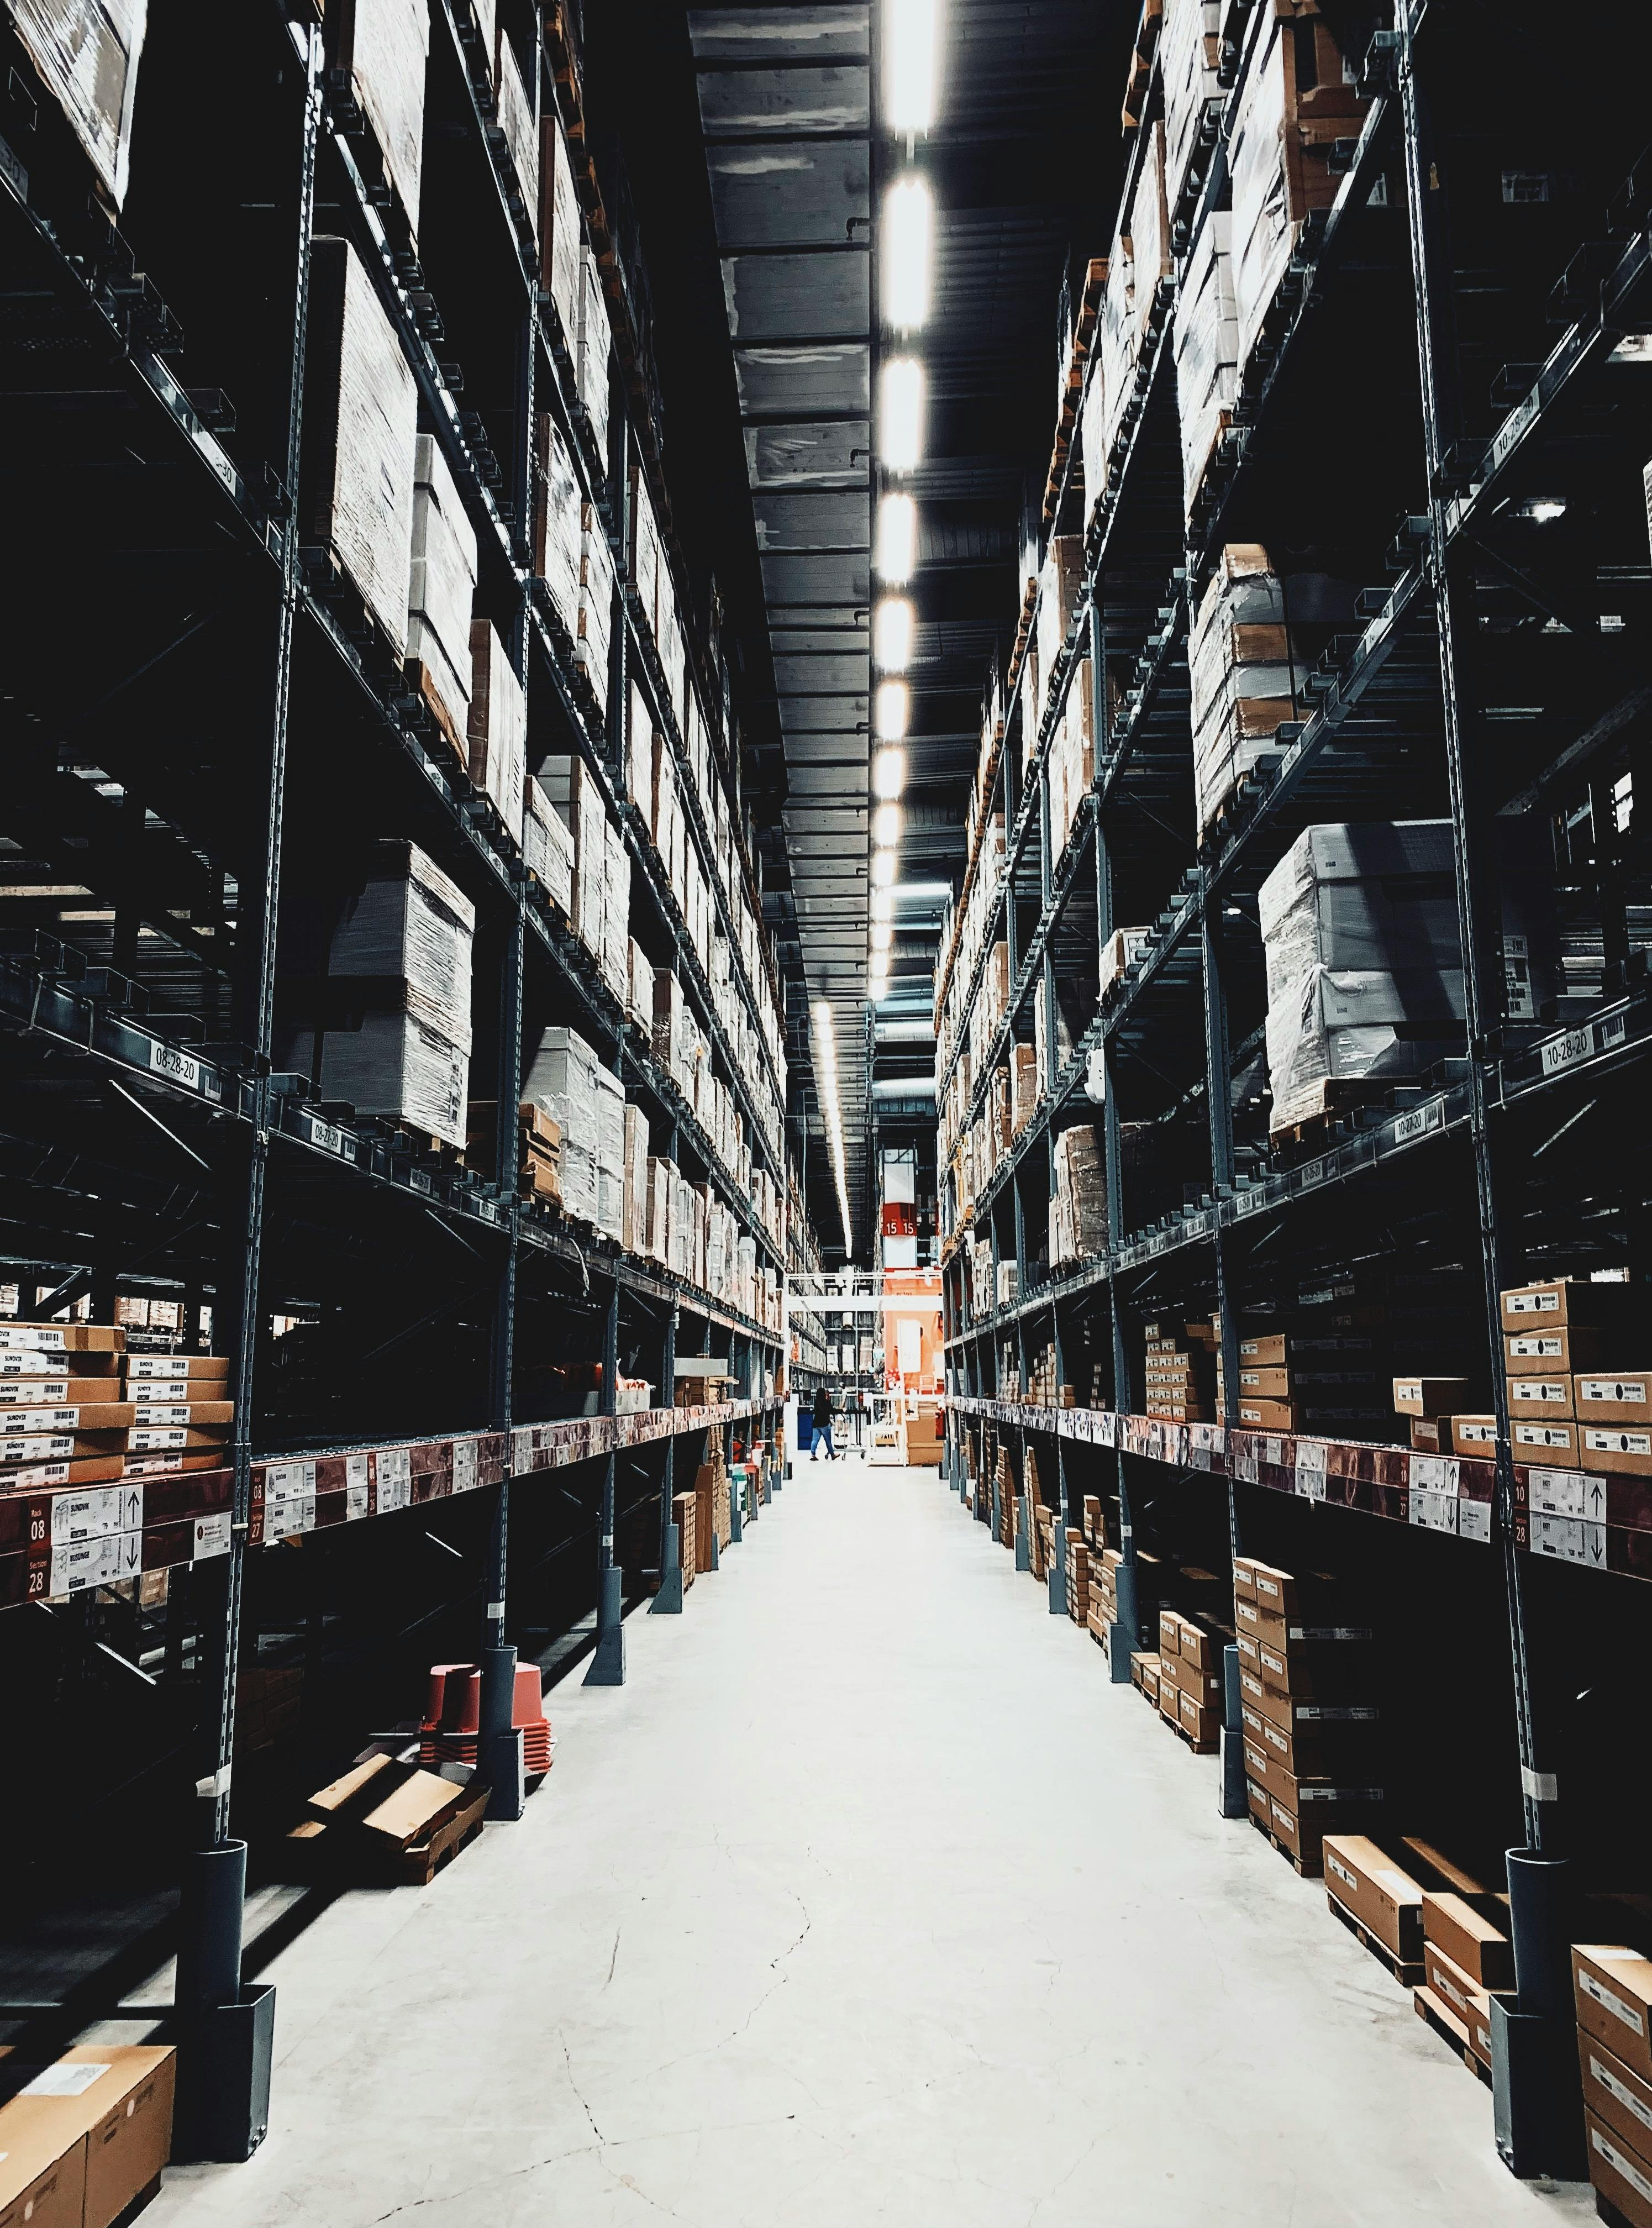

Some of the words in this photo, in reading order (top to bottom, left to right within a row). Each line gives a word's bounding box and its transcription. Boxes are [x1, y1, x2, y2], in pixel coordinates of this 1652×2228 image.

[1548, 1032, 1587, 1066] 10-28-20
[156, 1047, 194, 1080] 08-28-20
[1398, 1113, 1422, 1136] 10-27-20
[315, 1124, 339, 1147] 08-27-20
[886, 1222, 897, 1234] 15
[903, 1222, 914, 1234] 15
[254, 1484, 262, 1500] 08
[1516, 1486, 1524, 1501] 10
[31, 1520, 45, 1541] 08
[251, 1522, 260, 1538] 27
[1516, 1526, 1525, 1543] 28
[30, 1560, 48, 1570] Section
[29, 1572, 44, 1594] 28
